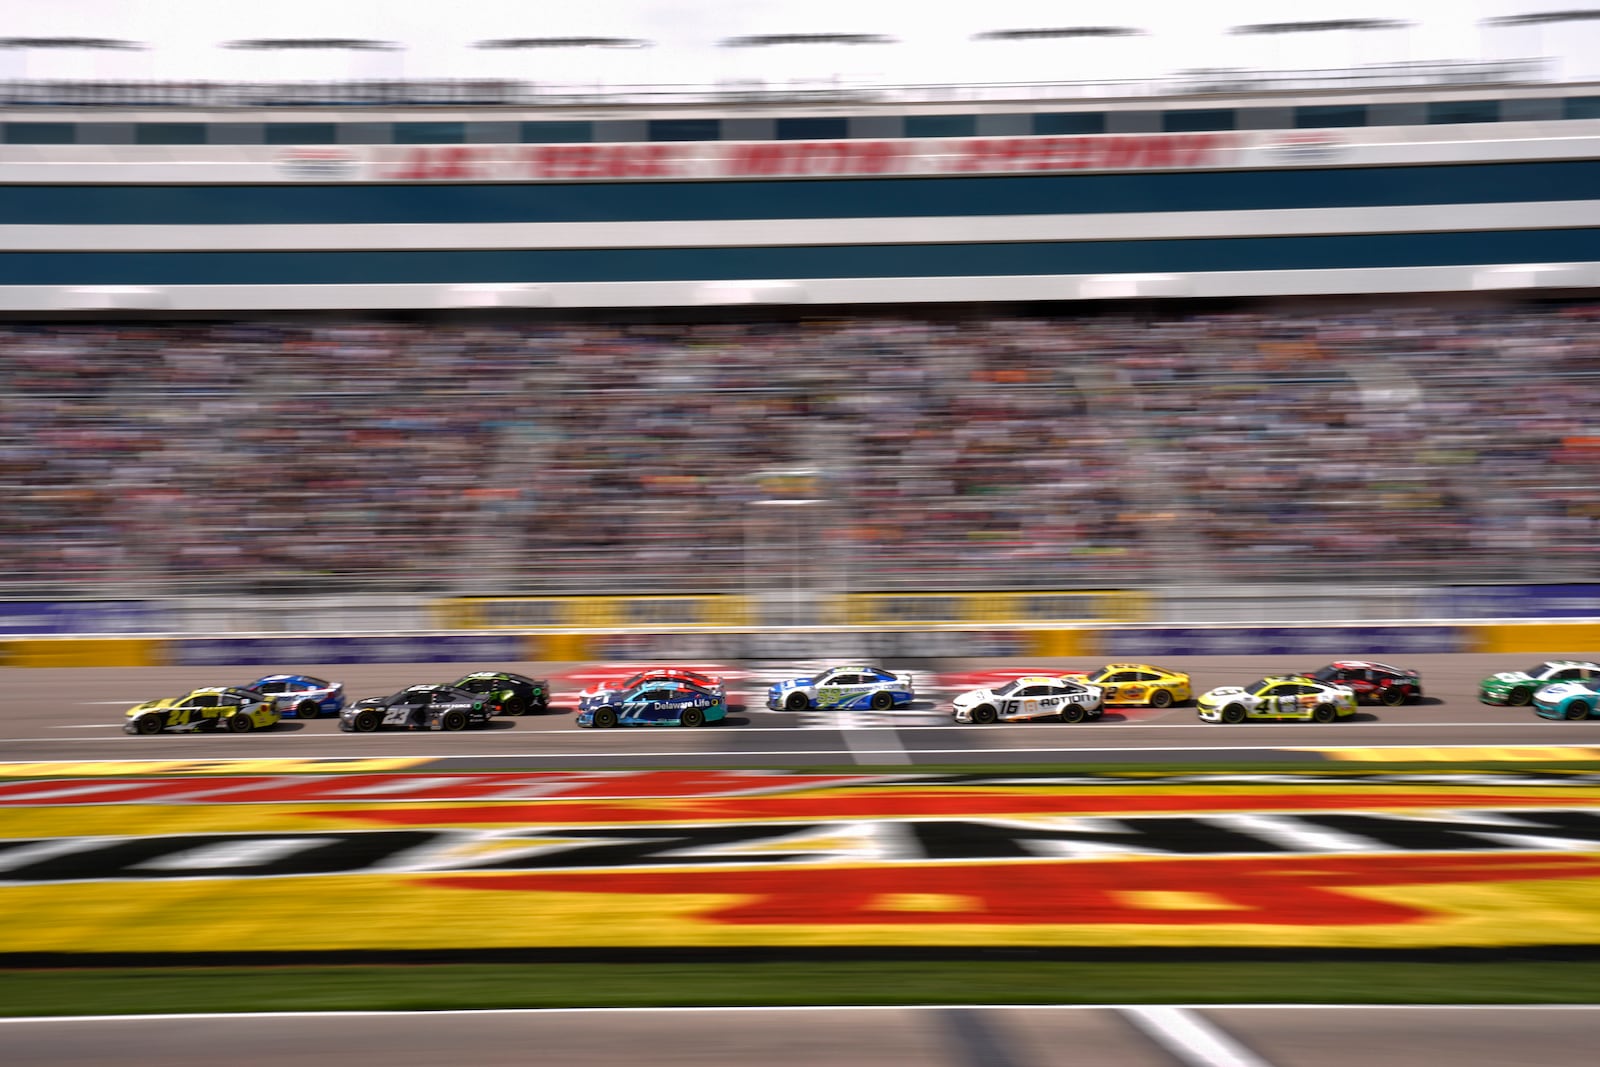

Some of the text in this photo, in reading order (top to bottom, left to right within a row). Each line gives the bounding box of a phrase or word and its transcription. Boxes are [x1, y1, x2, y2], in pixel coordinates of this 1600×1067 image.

[654, 699, 710, 711] Delaware Life
[1000, 699, 1020, 715] 16
[1040, 694, 1091, 708] ACTION
[1254, 699, 1270, 715] 4
[166, 709, 191, 726] 24
[381, 708, 411, 725] 23
[621, 702, 649, 719] 77
